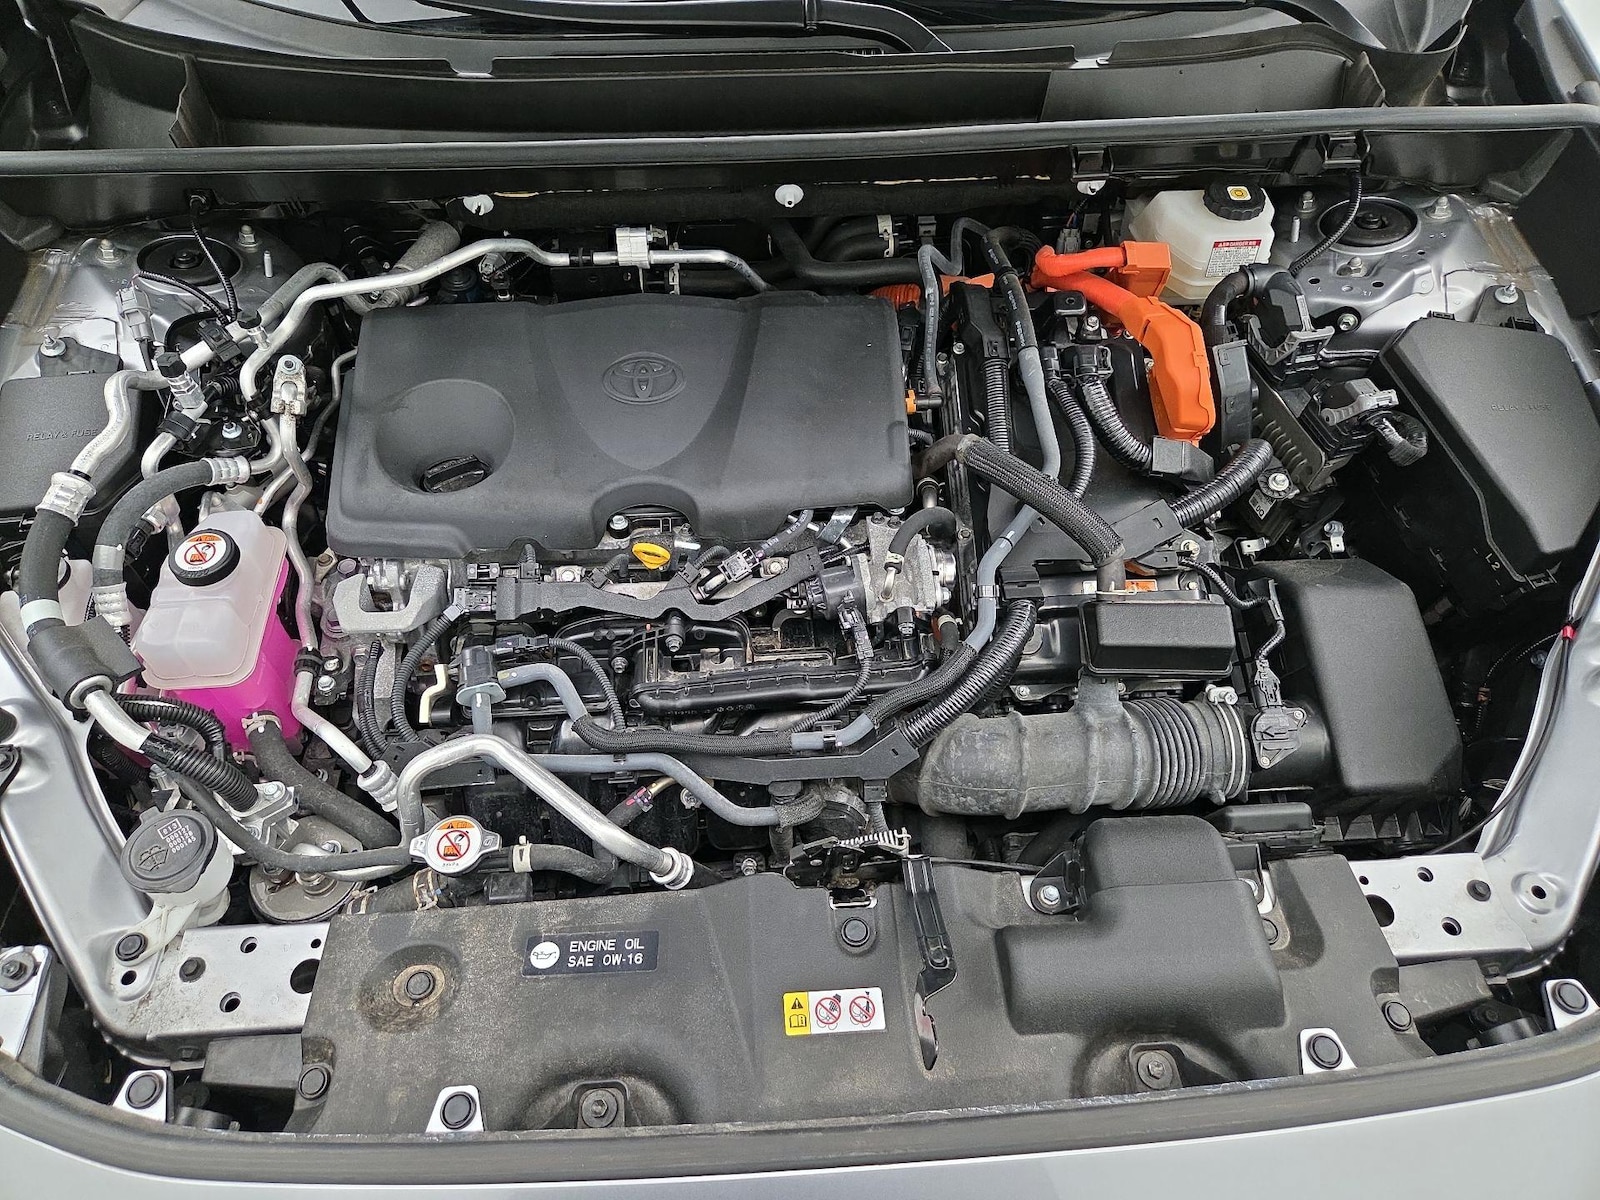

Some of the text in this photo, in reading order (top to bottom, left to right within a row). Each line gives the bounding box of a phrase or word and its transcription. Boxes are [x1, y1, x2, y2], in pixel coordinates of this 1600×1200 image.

[27, 431, 60, 441] RELAY
[61, 431, 68, 439] &
[71, 428, 98, 438] FUSE
[1485, 552, 1500, 571] L2
[165, 825, 190, 843] 000127
[569, 938, 645, 952] ENGINE OIL
[567, 955, 595, 967] SAE
